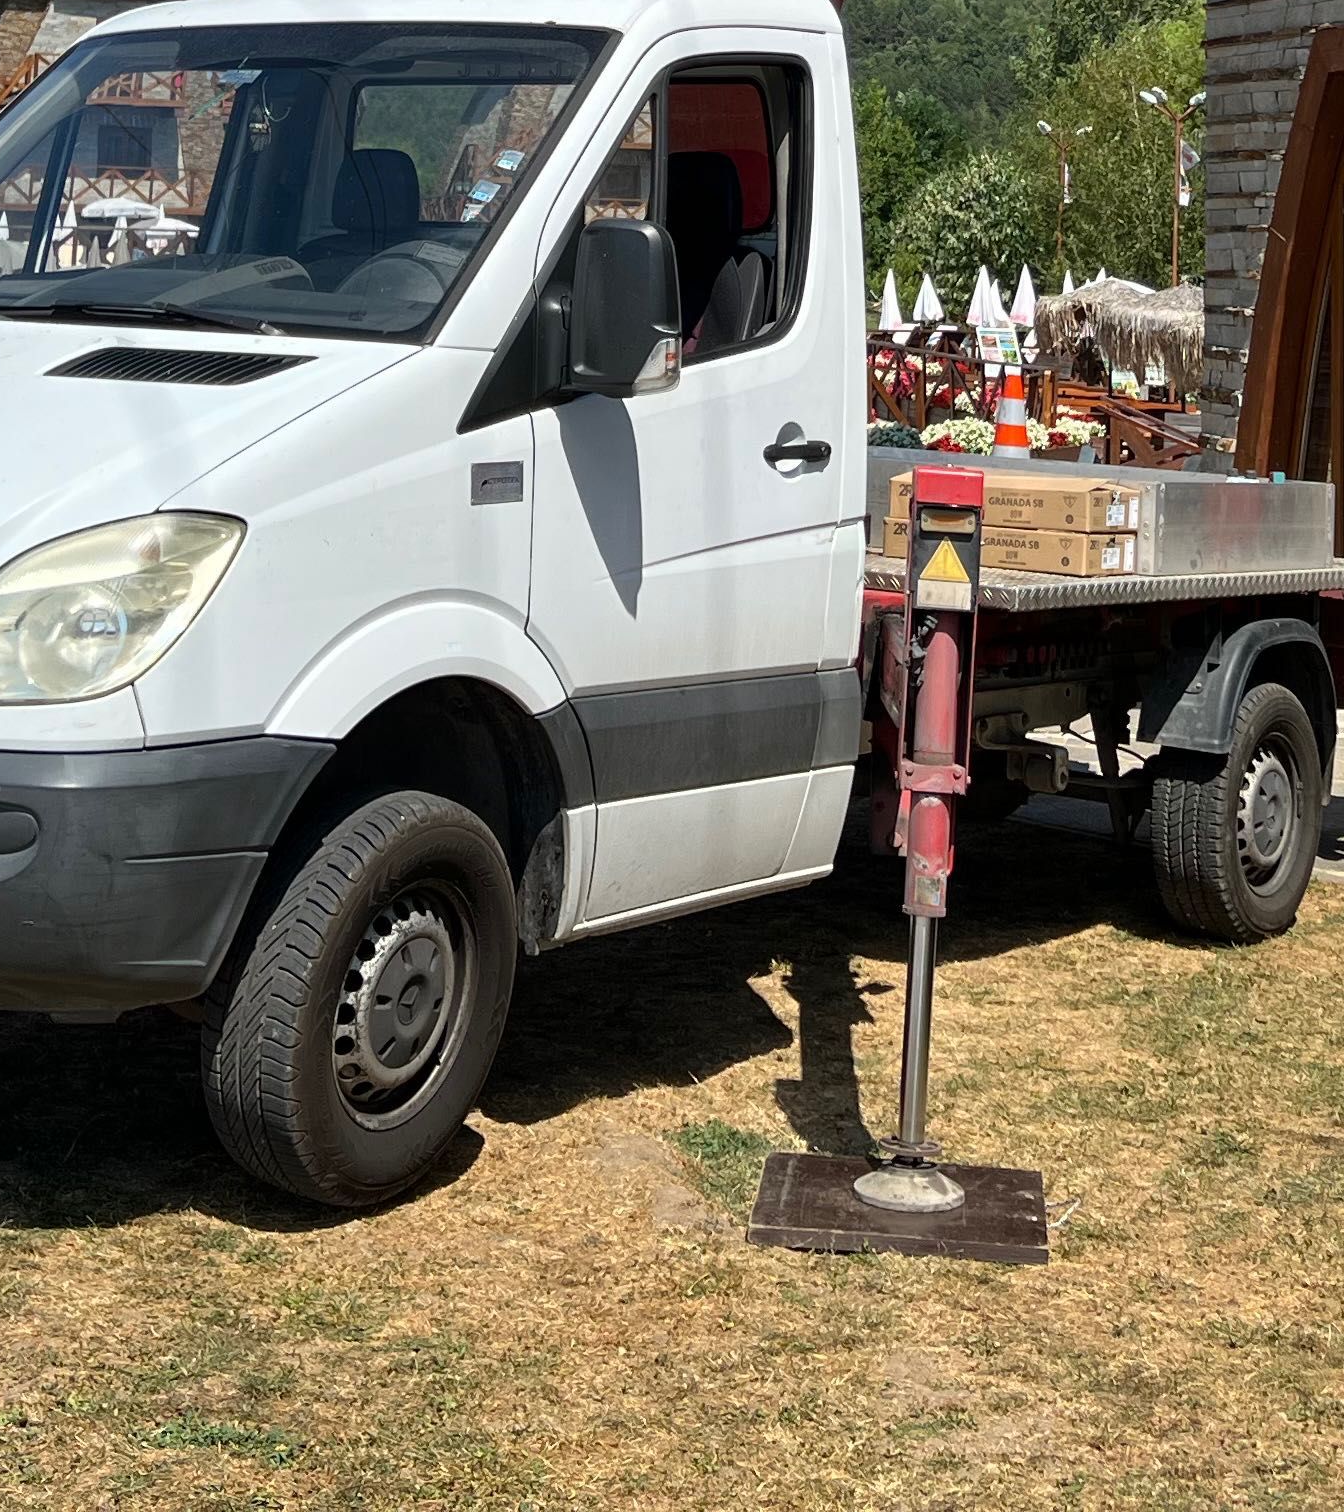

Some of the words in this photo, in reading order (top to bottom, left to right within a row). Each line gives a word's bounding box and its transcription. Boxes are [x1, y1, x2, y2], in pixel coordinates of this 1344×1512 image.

[988, 496, 1031, 508] GRANADA
[1033, 498, 1044, 508] SB
[984, 537, 1027, 549] GRANADA
[1028, 540, 1040, 550] SB
